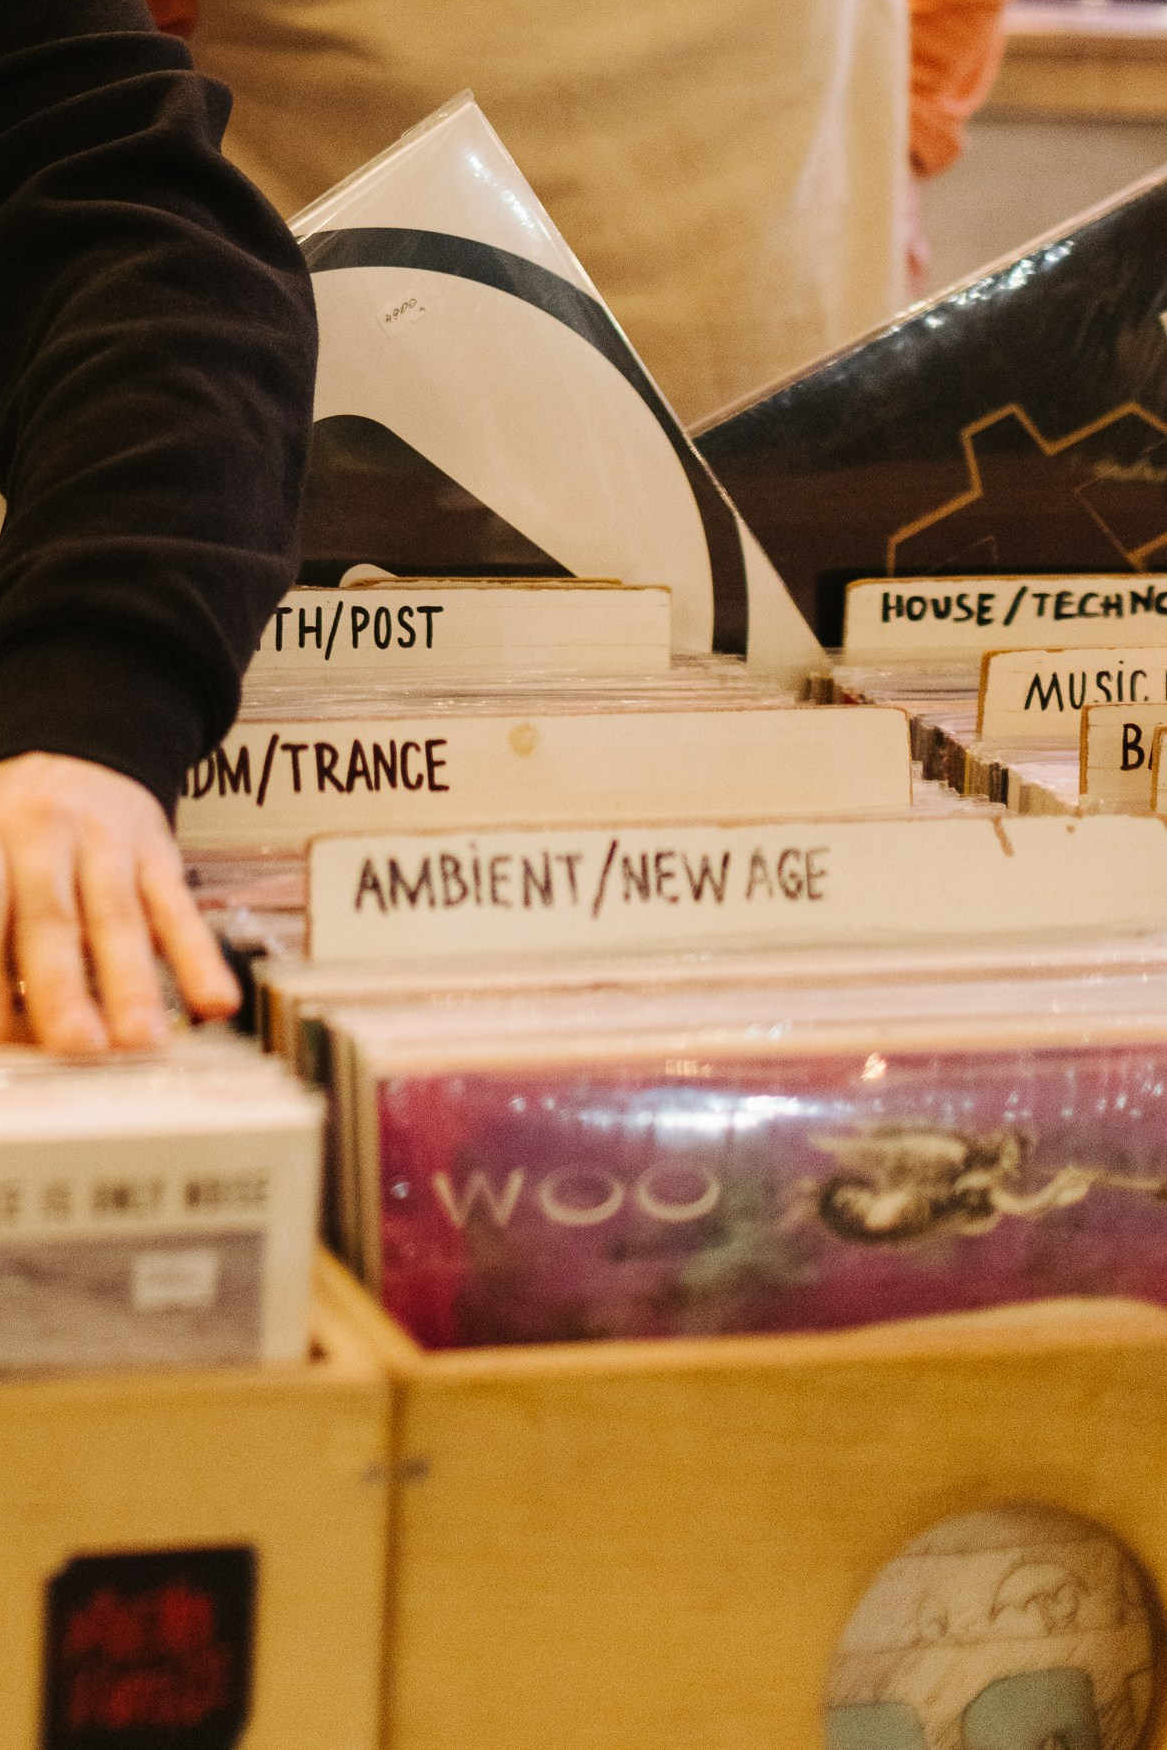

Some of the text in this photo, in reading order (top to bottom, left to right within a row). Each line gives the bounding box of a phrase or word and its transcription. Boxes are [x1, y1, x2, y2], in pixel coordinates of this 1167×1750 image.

[254, 600, 444, 661] TH/POST
[1119, 722, 1154, 772] B
[745, 846, 833, 902] AGE
[433, 1158, 723, 1230] WOO
